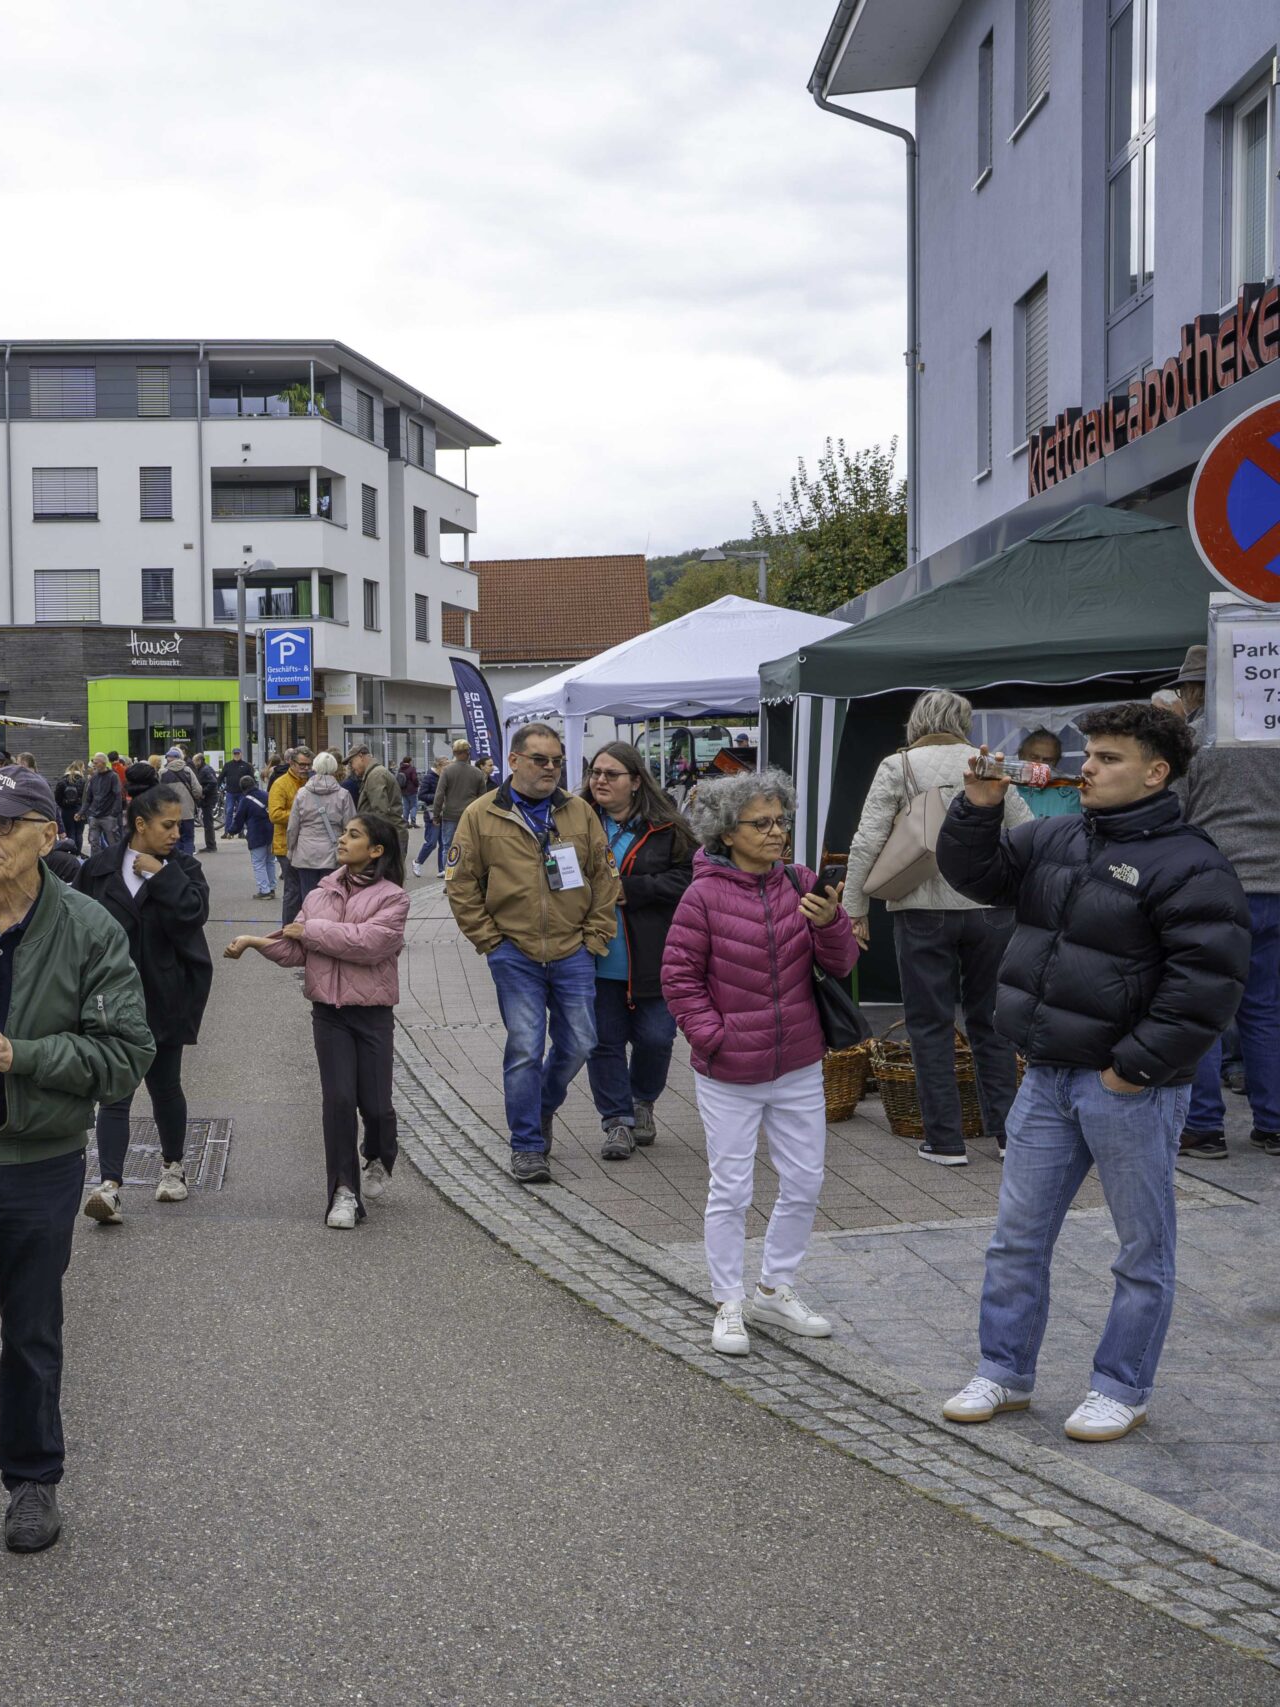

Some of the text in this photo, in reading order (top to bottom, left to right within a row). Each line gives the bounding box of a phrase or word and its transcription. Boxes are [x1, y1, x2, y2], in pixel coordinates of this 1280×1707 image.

[126, 629, 183, 656] Hauser
[279, 641, 296, 665] P
[1232, 642, 1280, 658] Park
[131, 657, 148, 666] dein
[267, 665, 302, 674] Geschäfts-
[267, 675, 310, 683] Ärztezentrum
